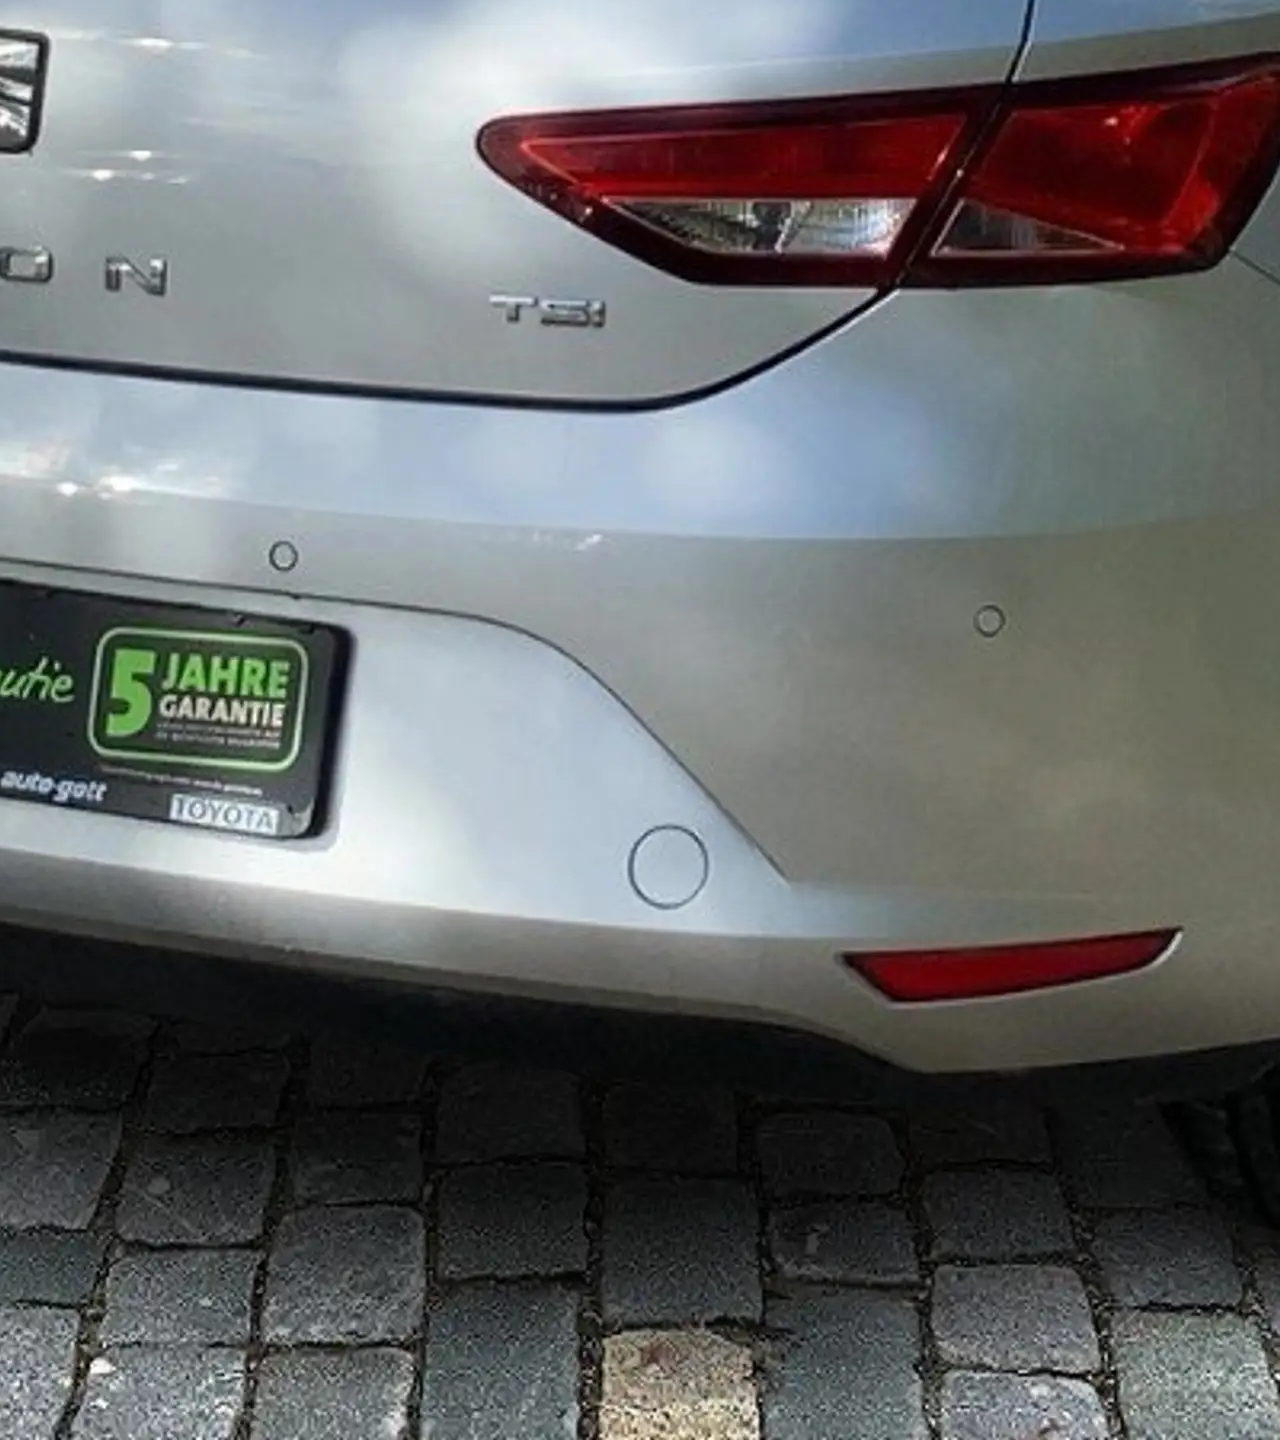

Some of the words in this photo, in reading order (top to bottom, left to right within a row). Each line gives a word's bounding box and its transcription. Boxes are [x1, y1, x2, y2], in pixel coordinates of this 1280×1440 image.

[106, 648, 156, 738] 5
[161, 651, 291, 699] JAHRE
[159, 694, 286, 728] GARANTIE
[173, 796, 277, 833] TOYOTA
